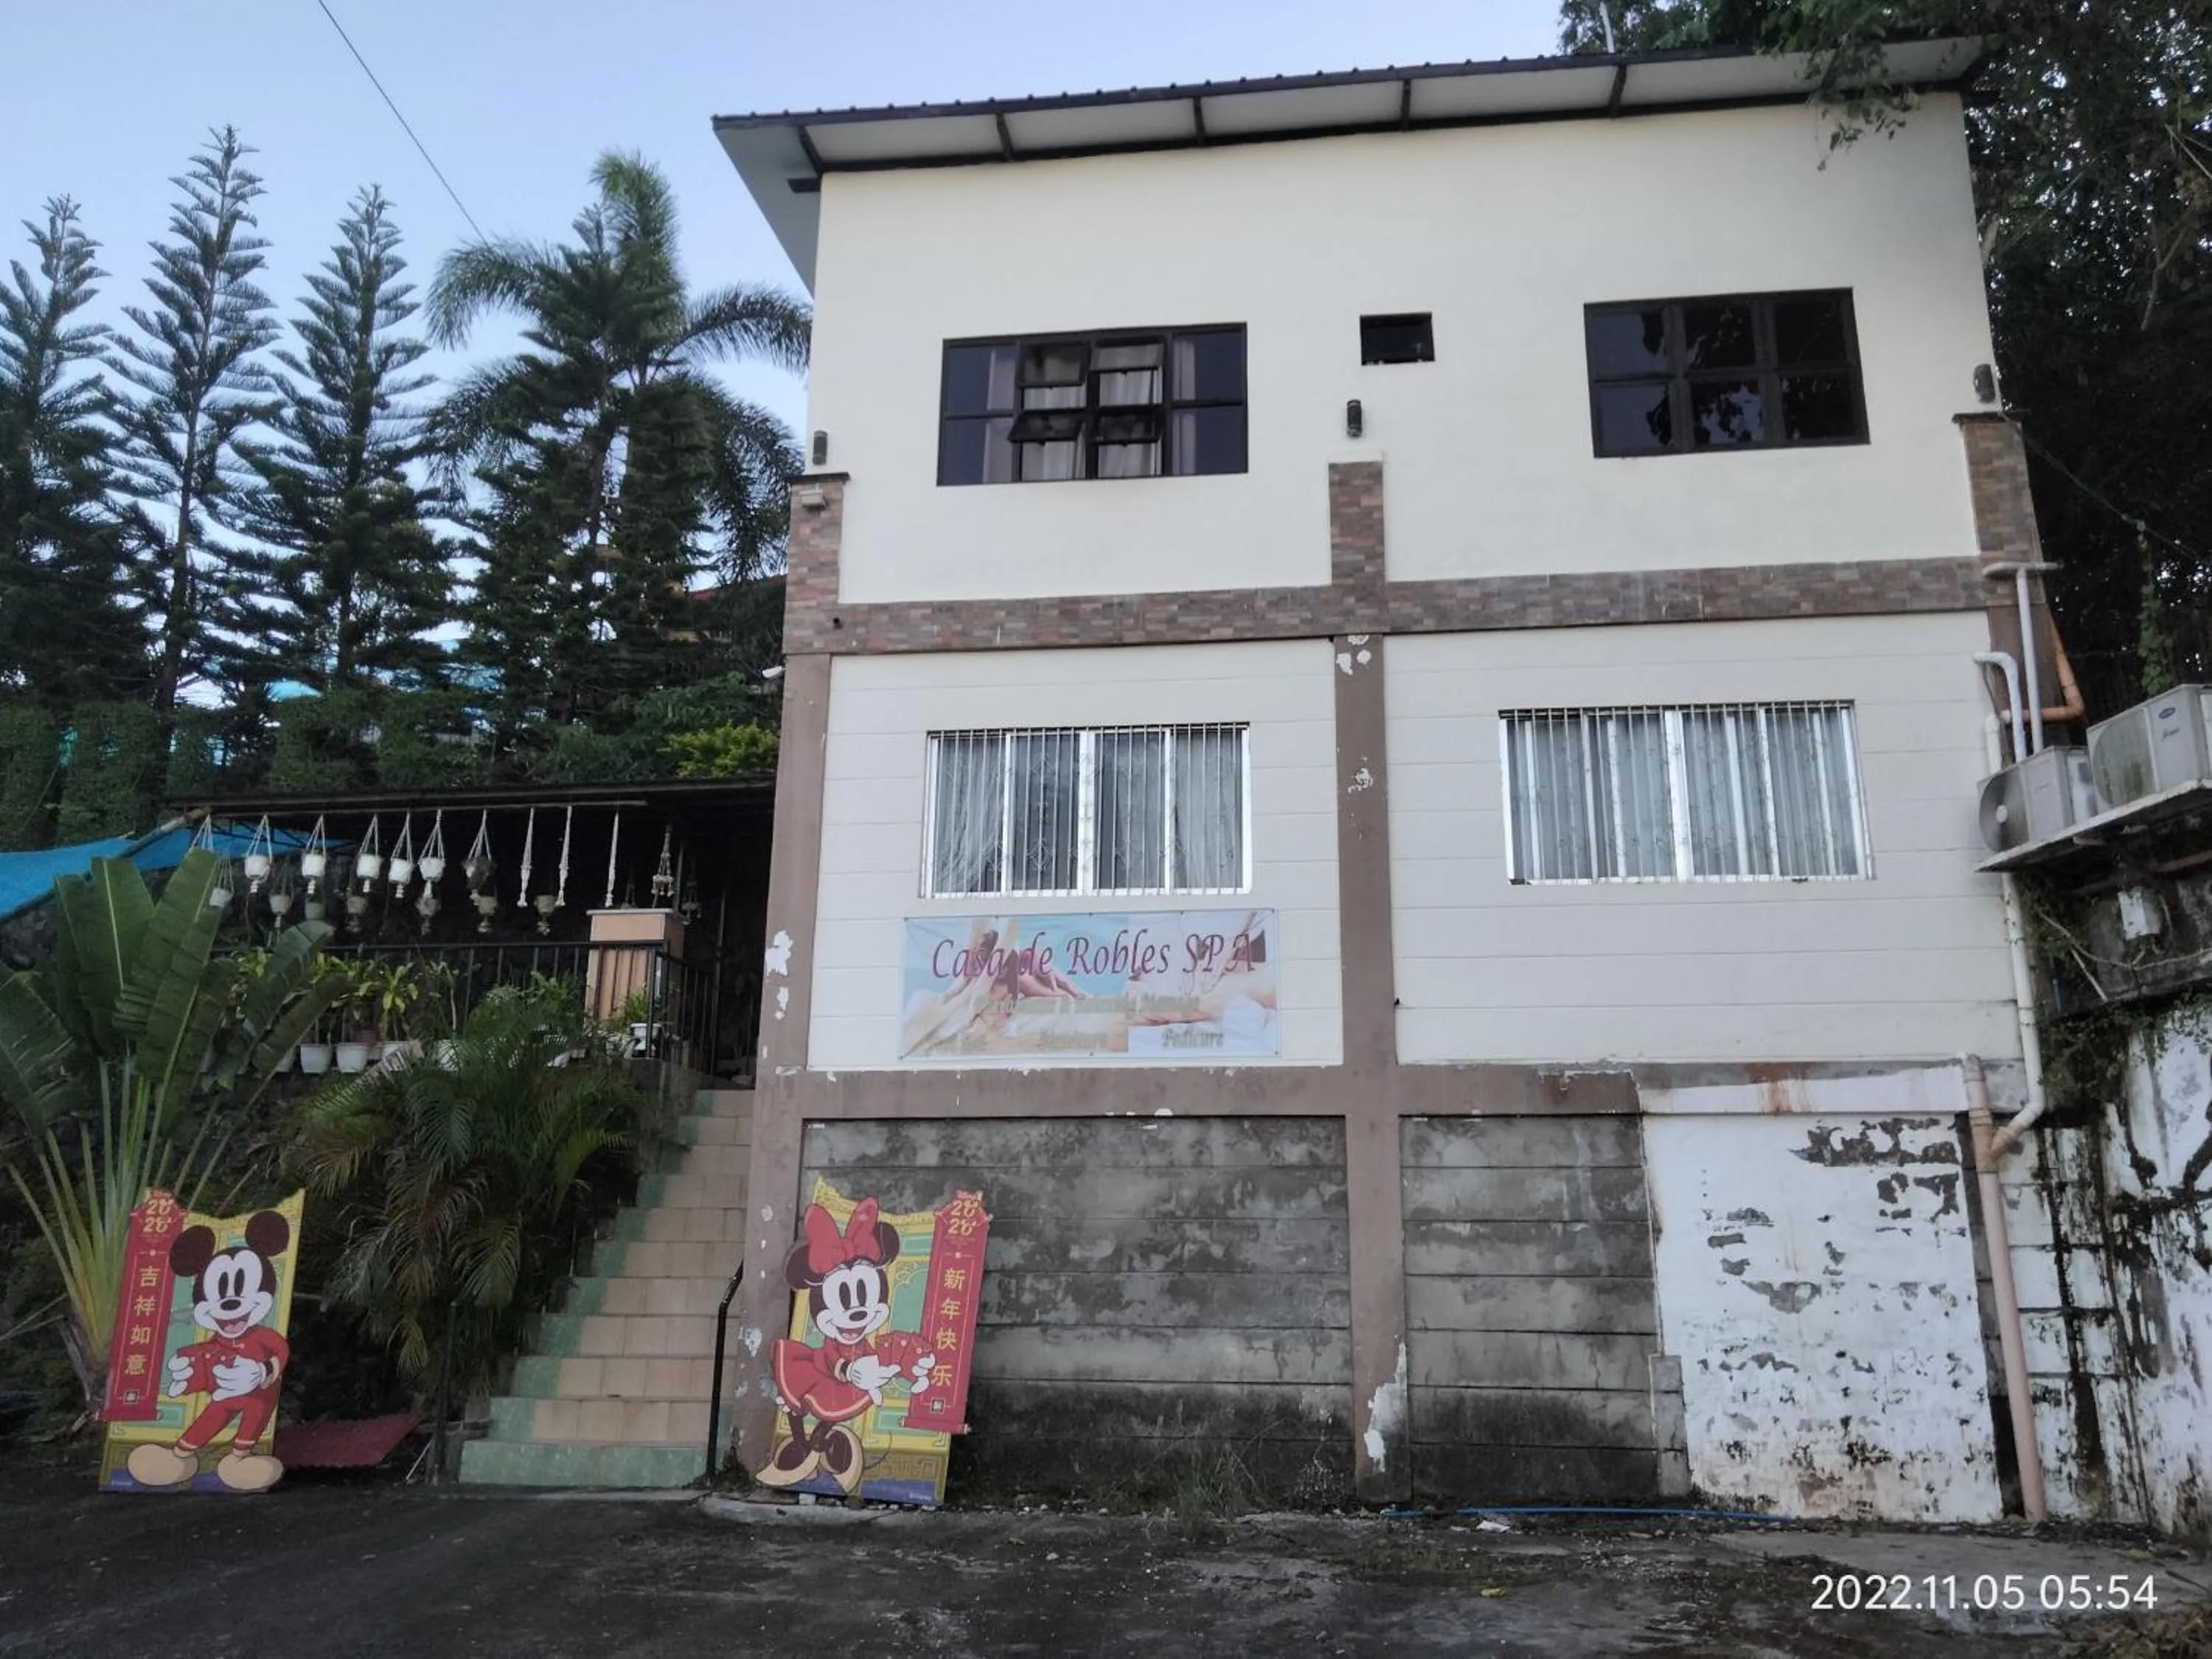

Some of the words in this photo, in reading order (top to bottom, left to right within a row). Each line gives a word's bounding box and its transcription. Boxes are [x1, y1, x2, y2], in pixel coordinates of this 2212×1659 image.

[932, 937, 1009, 979] Casa
[1018, 931, 1052, 976] de
[1066, 929, 1171, 975] Robles
[1182, 931, 1256, 975] SPA
[124, 1266, 160, 1375] 吉祥如意
[932, 1268, 966, 1387] 新年快乐
